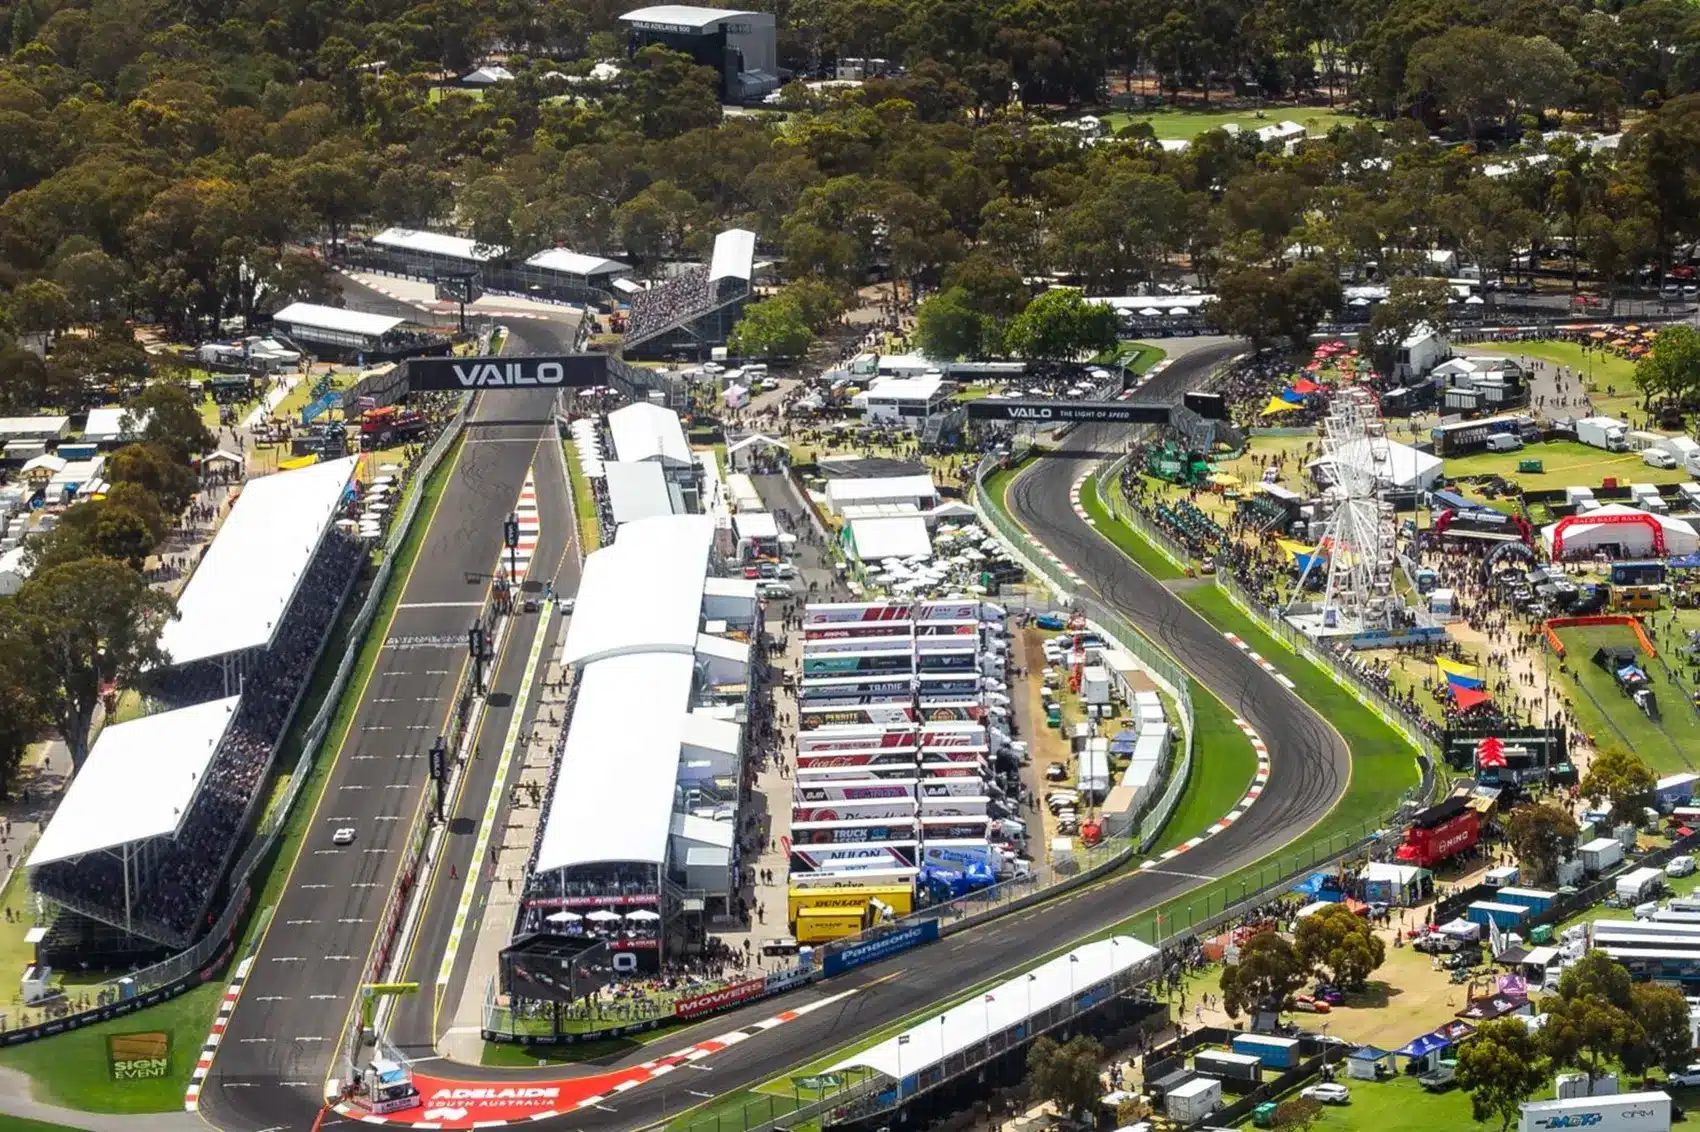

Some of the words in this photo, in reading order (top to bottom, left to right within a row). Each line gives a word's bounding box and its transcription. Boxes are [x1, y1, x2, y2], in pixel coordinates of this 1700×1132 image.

[453, 362, 563, 386] VAILO
[1008, 407, 1052, 418] VAILO
[832, 828, 868, 838] TRUCK
[1446, 830, 1469, 848] HINO
[814, 899, 866, 908] DUNLOP
[841, 927, 922, 961] Panasonic
[767, 967, 809, 985] PLUS
[679, 981, 763, 1012] MOWERS
[114, 1058, 167, 1071] SIGN
[115, 1067, 165, 1079] EVENT
[433, 1088, 560, 1099] ADELAIDE
[479, 1099, 555, 1107] AUSTRALIA
